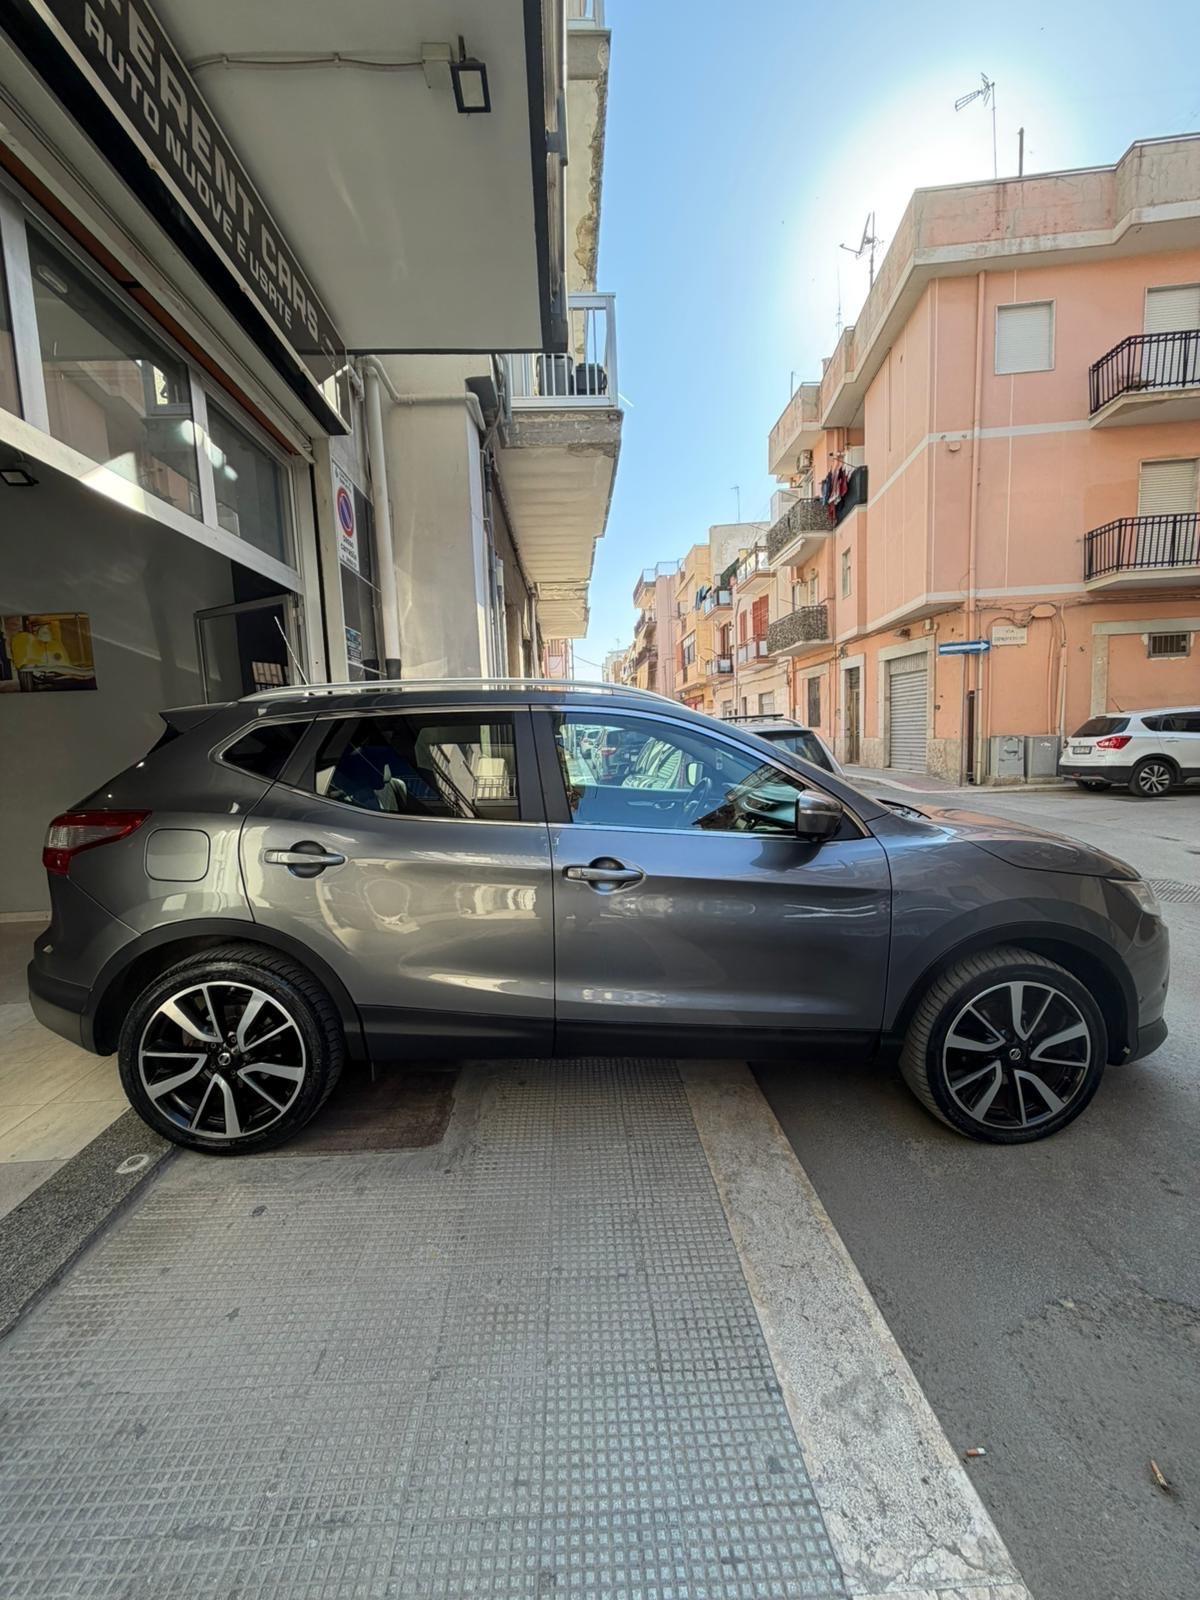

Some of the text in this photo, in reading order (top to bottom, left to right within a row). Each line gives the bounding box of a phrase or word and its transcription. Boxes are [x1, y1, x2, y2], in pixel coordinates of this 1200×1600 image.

[84, 2, 293, 330] AUTO NUOVE E USATE
[97, 0, 319, 344] ERENT CARS
